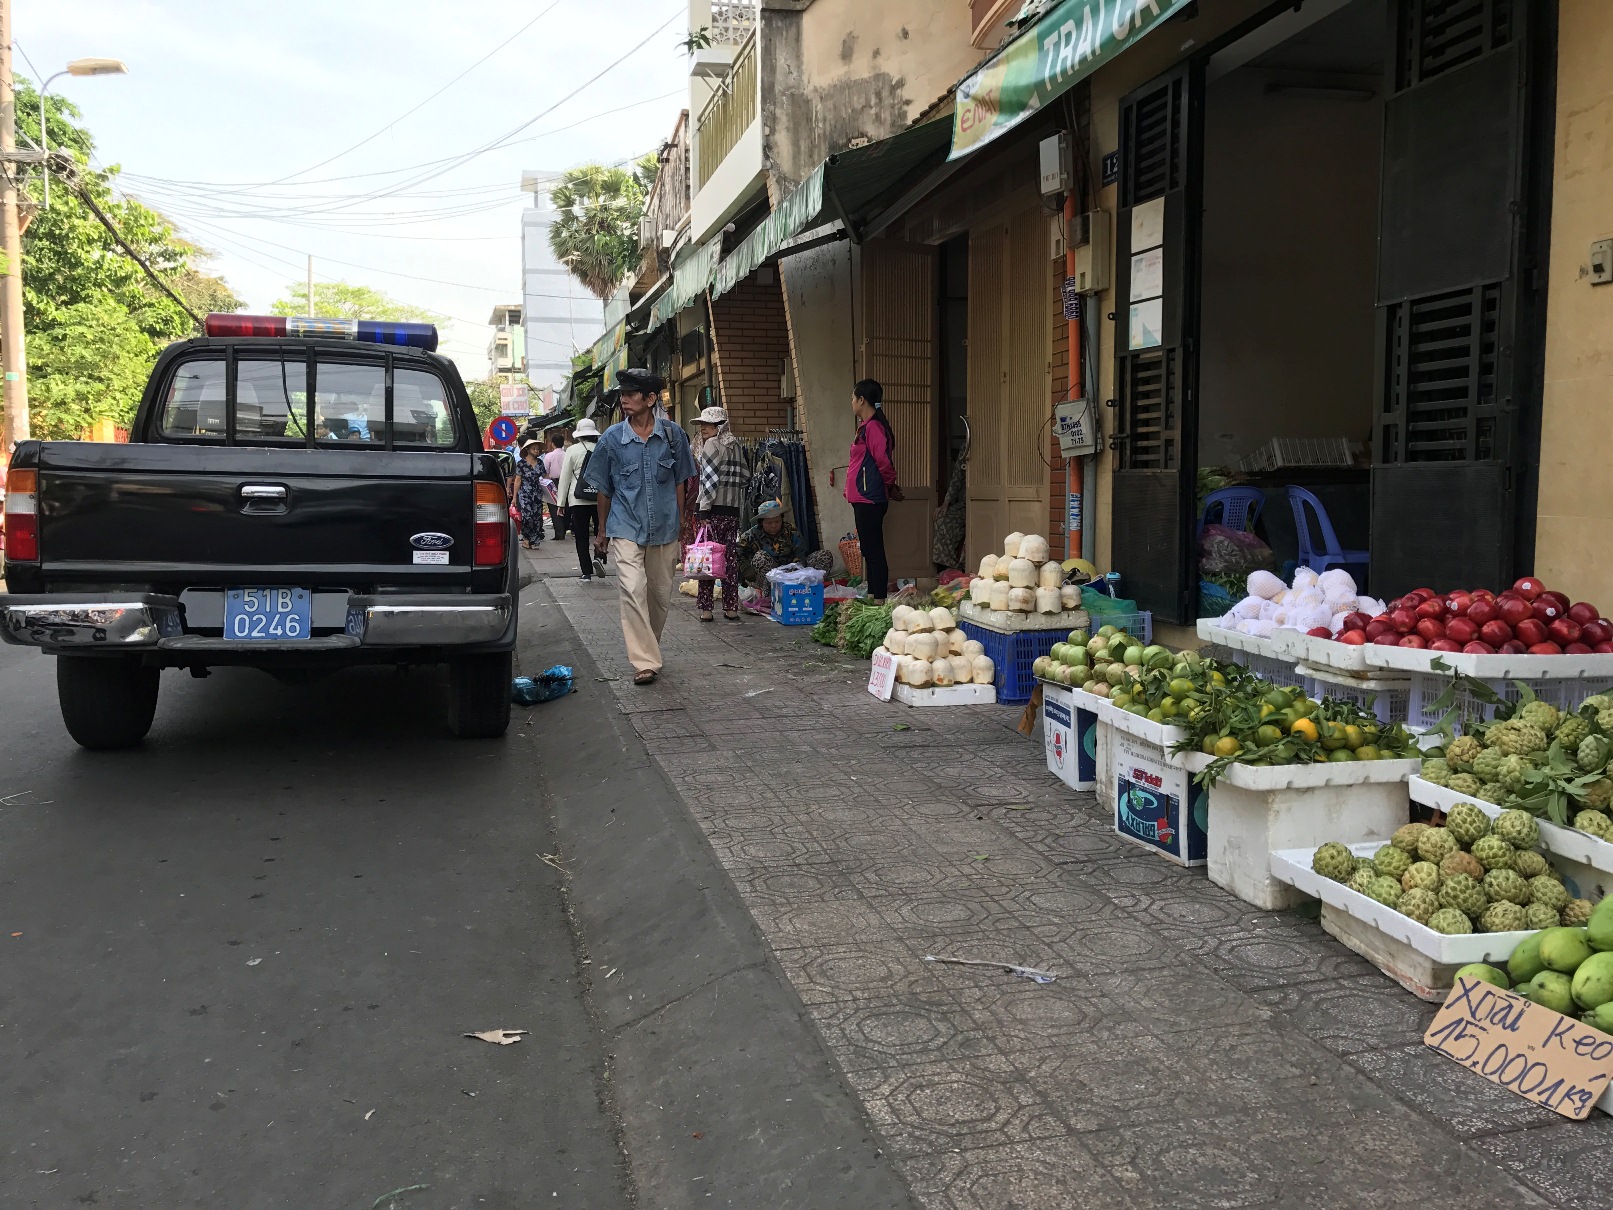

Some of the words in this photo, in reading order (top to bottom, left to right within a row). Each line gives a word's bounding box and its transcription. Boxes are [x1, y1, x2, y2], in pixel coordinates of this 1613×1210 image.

[516, 387, 527, 397] XE
[420, 535, 444, 545] Ford
[243, 588, 293, 612] 51B
[234, 614, 301, 637] 0246
[1132, 768, 1162, 788] APPLES
[1126, 811, 1156, 839] GALAXY
